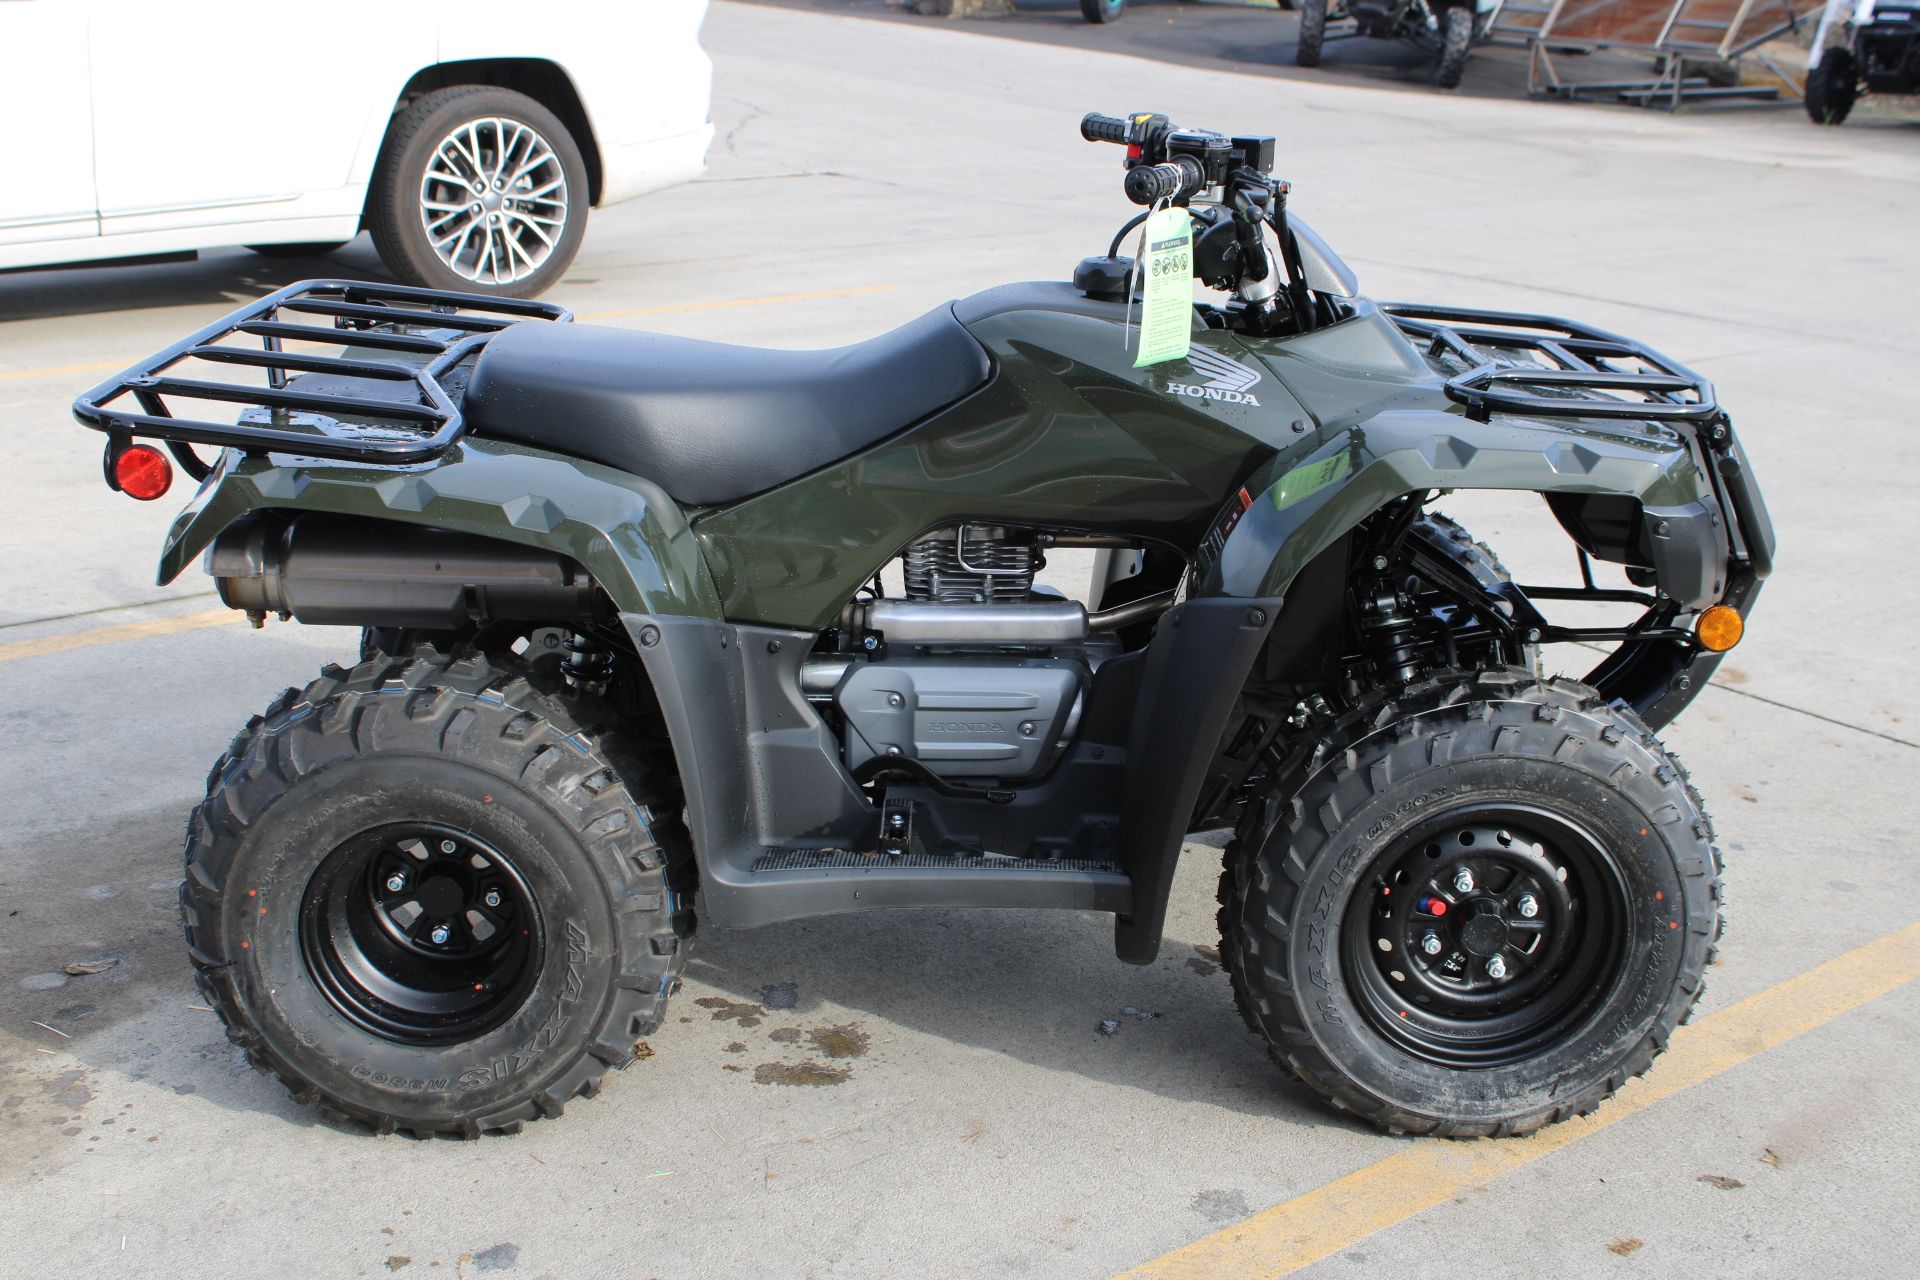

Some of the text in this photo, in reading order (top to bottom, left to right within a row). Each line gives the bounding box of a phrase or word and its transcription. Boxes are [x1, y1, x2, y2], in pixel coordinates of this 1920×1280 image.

[1166, 382, 1260, 407] HONDA
[928, 722, 1007, 733] HONDA
[1308, 843, 1362, 1026] MAXXIS
[456, 920, 588, 1091] MAXXIS
